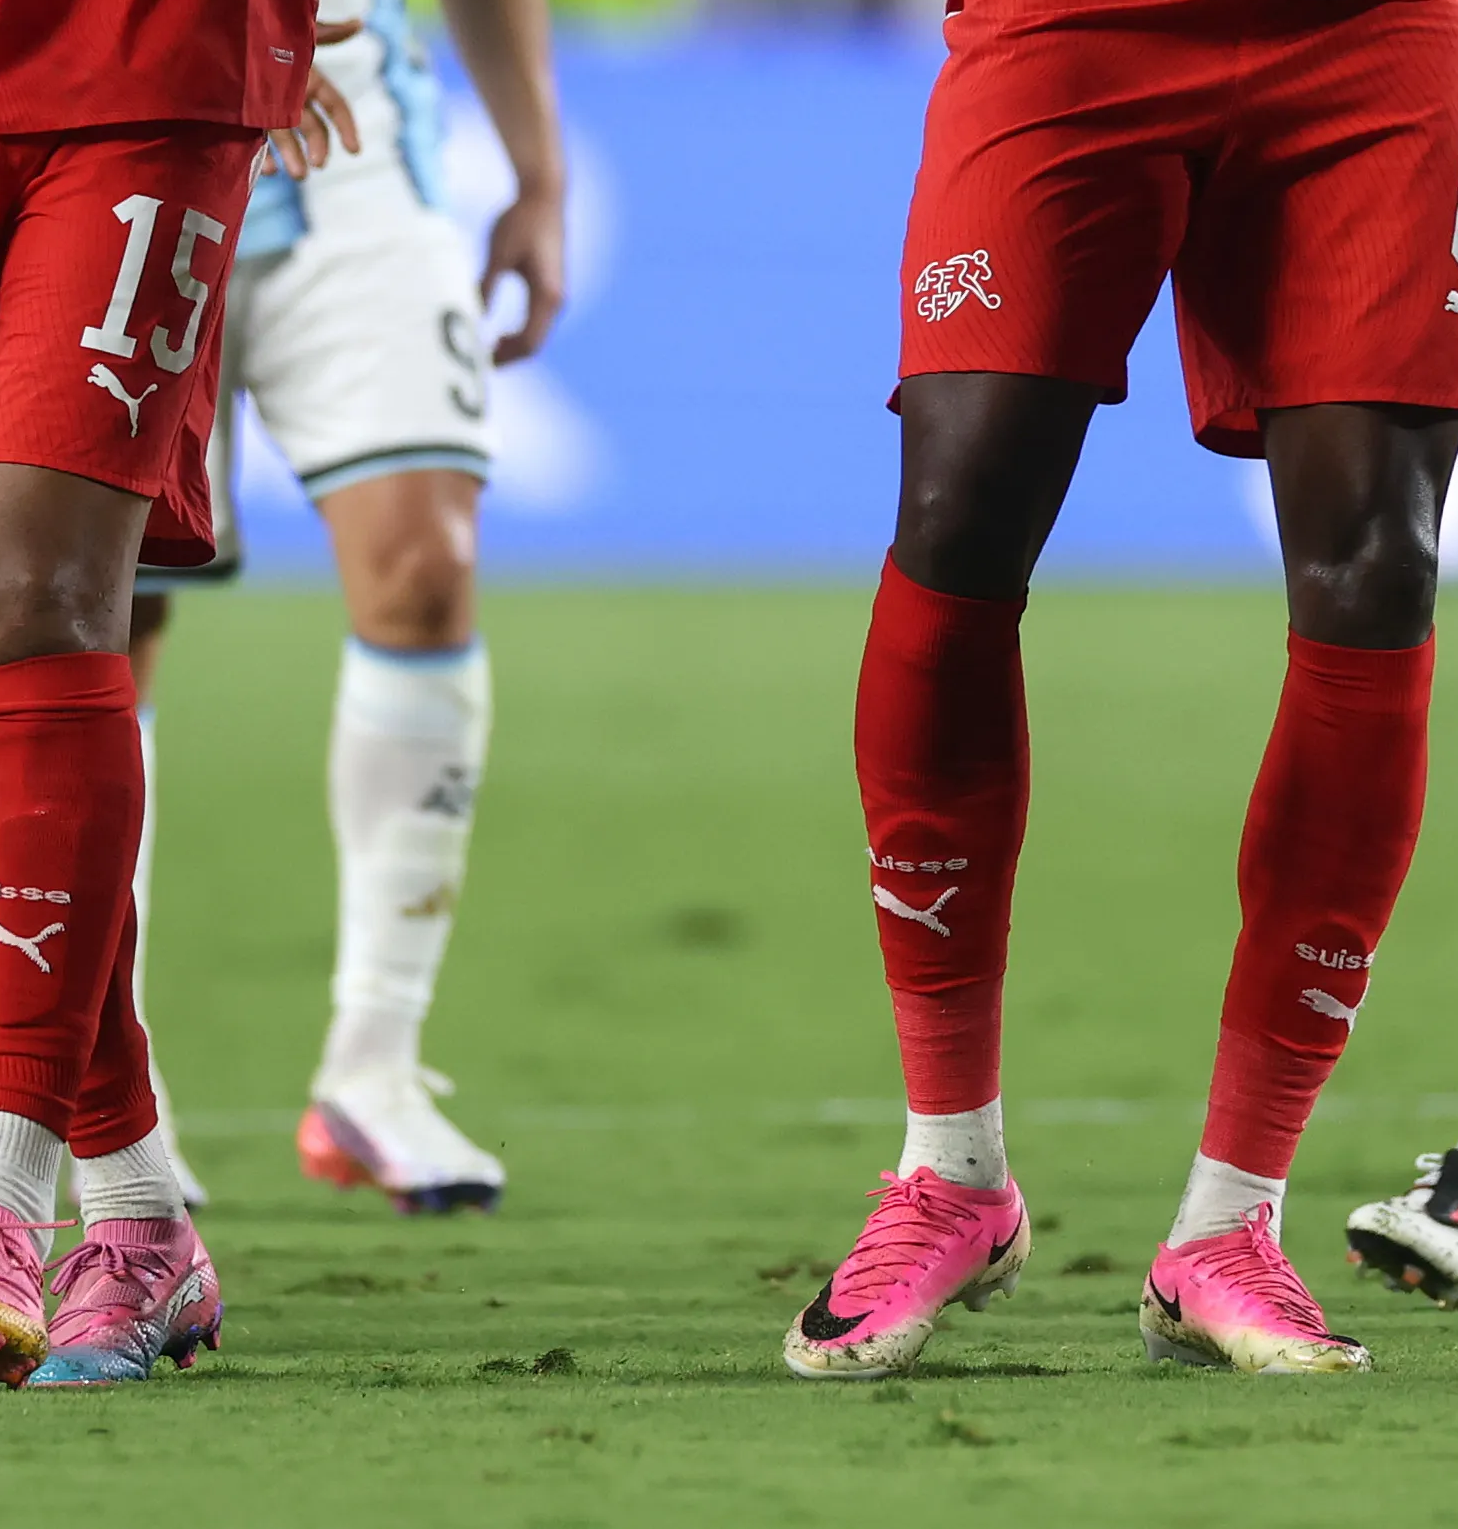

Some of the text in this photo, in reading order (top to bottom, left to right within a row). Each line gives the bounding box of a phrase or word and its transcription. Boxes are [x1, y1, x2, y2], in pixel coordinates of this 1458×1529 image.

[80, 194, 226, 375] 15
[864, 846, 968, 874] uisse
[1294, 943, 1375, 970] suiss
